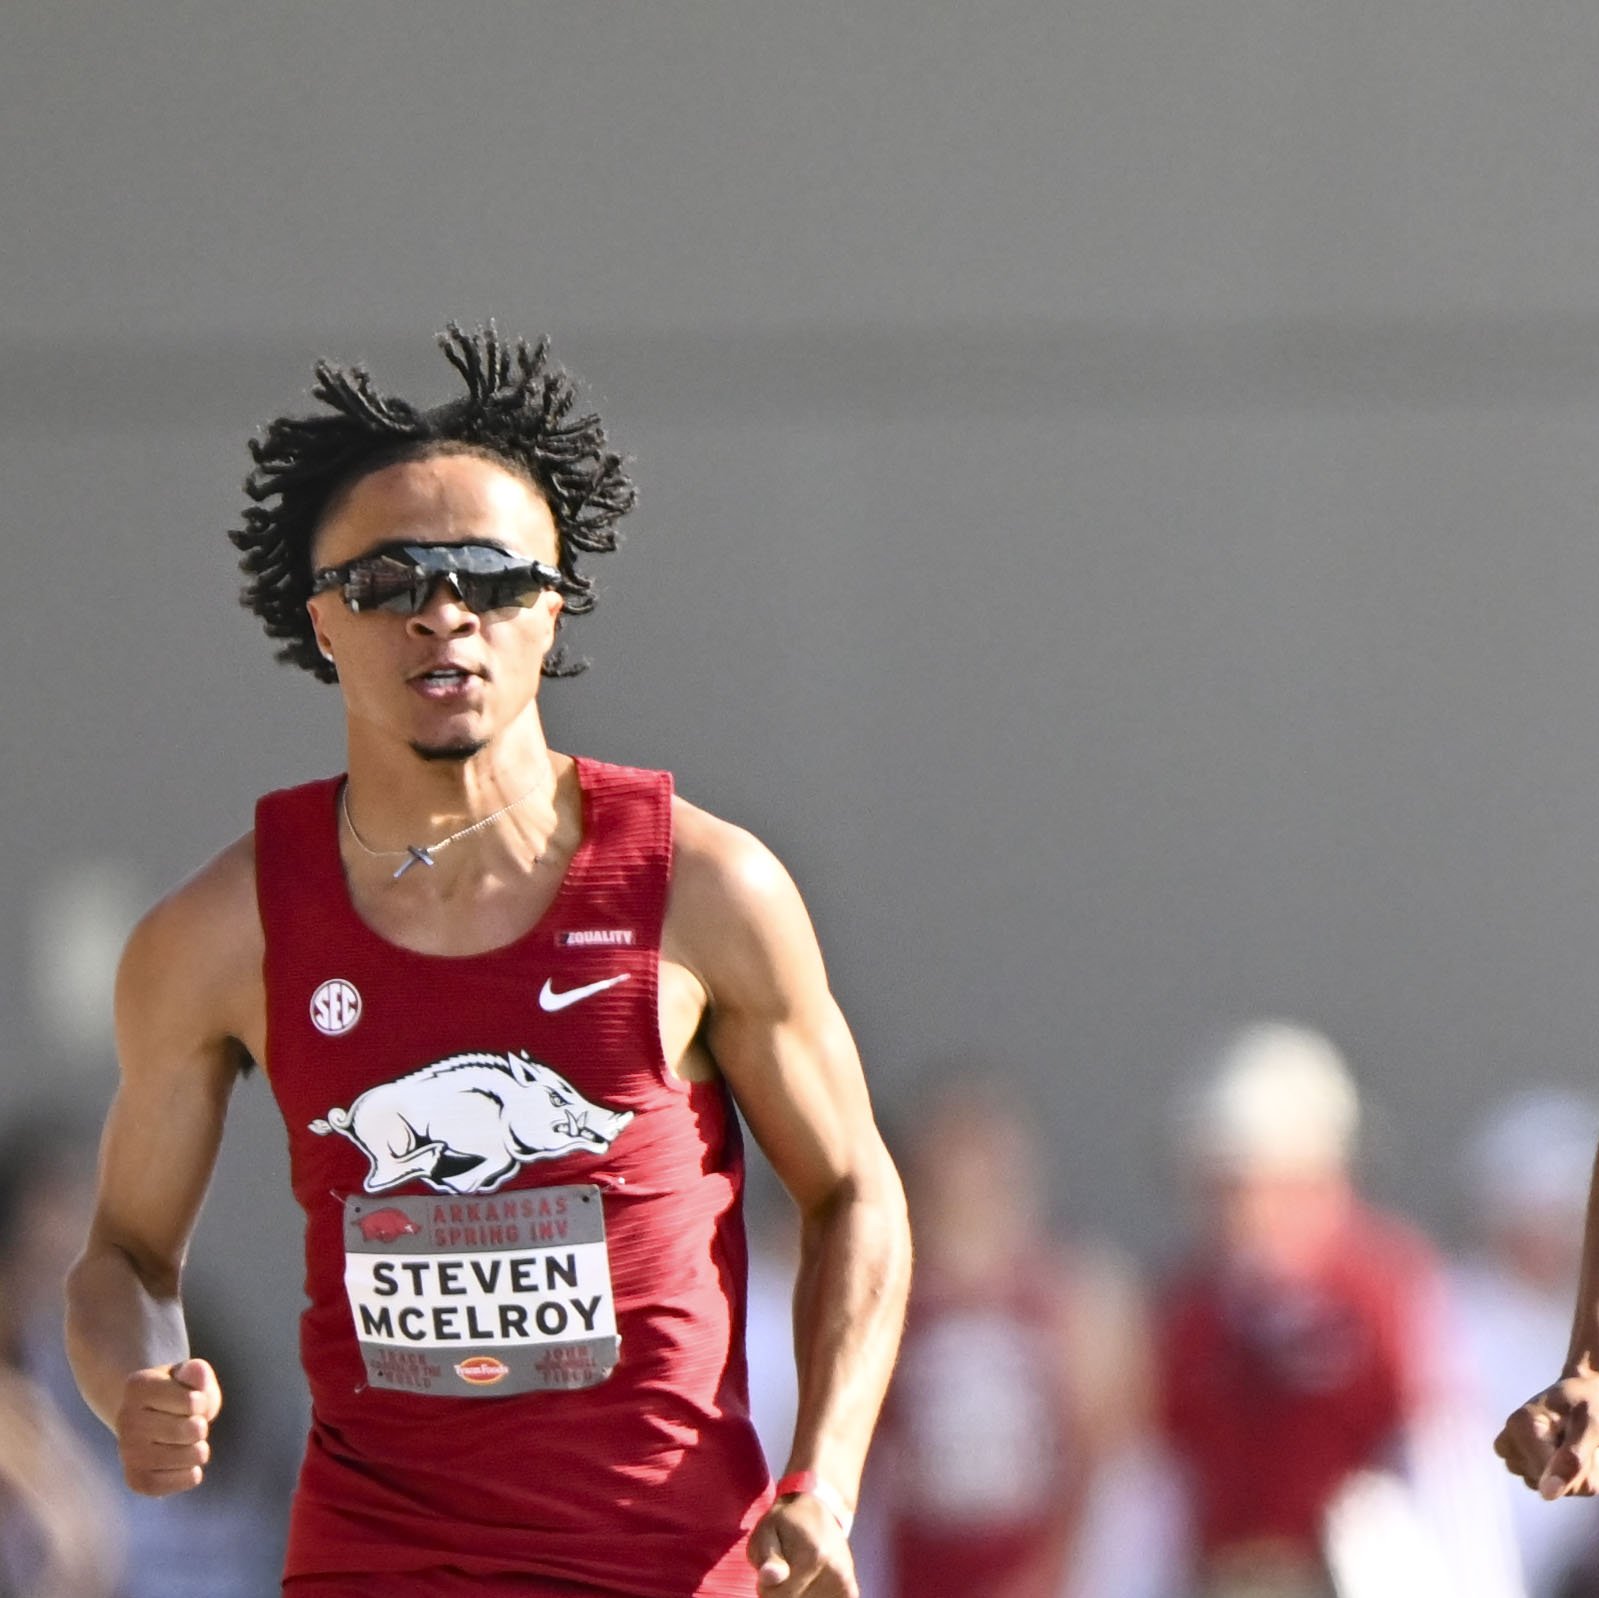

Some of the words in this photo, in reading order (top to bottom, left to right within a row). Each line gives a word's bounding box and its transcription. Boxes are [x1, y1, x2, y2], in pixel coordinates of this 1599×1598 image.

[567, 930, 632, 944] EQUALITY
[313, 982, 358, 1030] SEC
[433, 1198, 569, 1223] ARKANSAS
[434, 1224, 519, 1246] SPRING
[530, 1220, 568, 1241] INV
[373, 1254, 578, 1296] STEVEN
[360, 1295, 603, 1341] MCELROY
